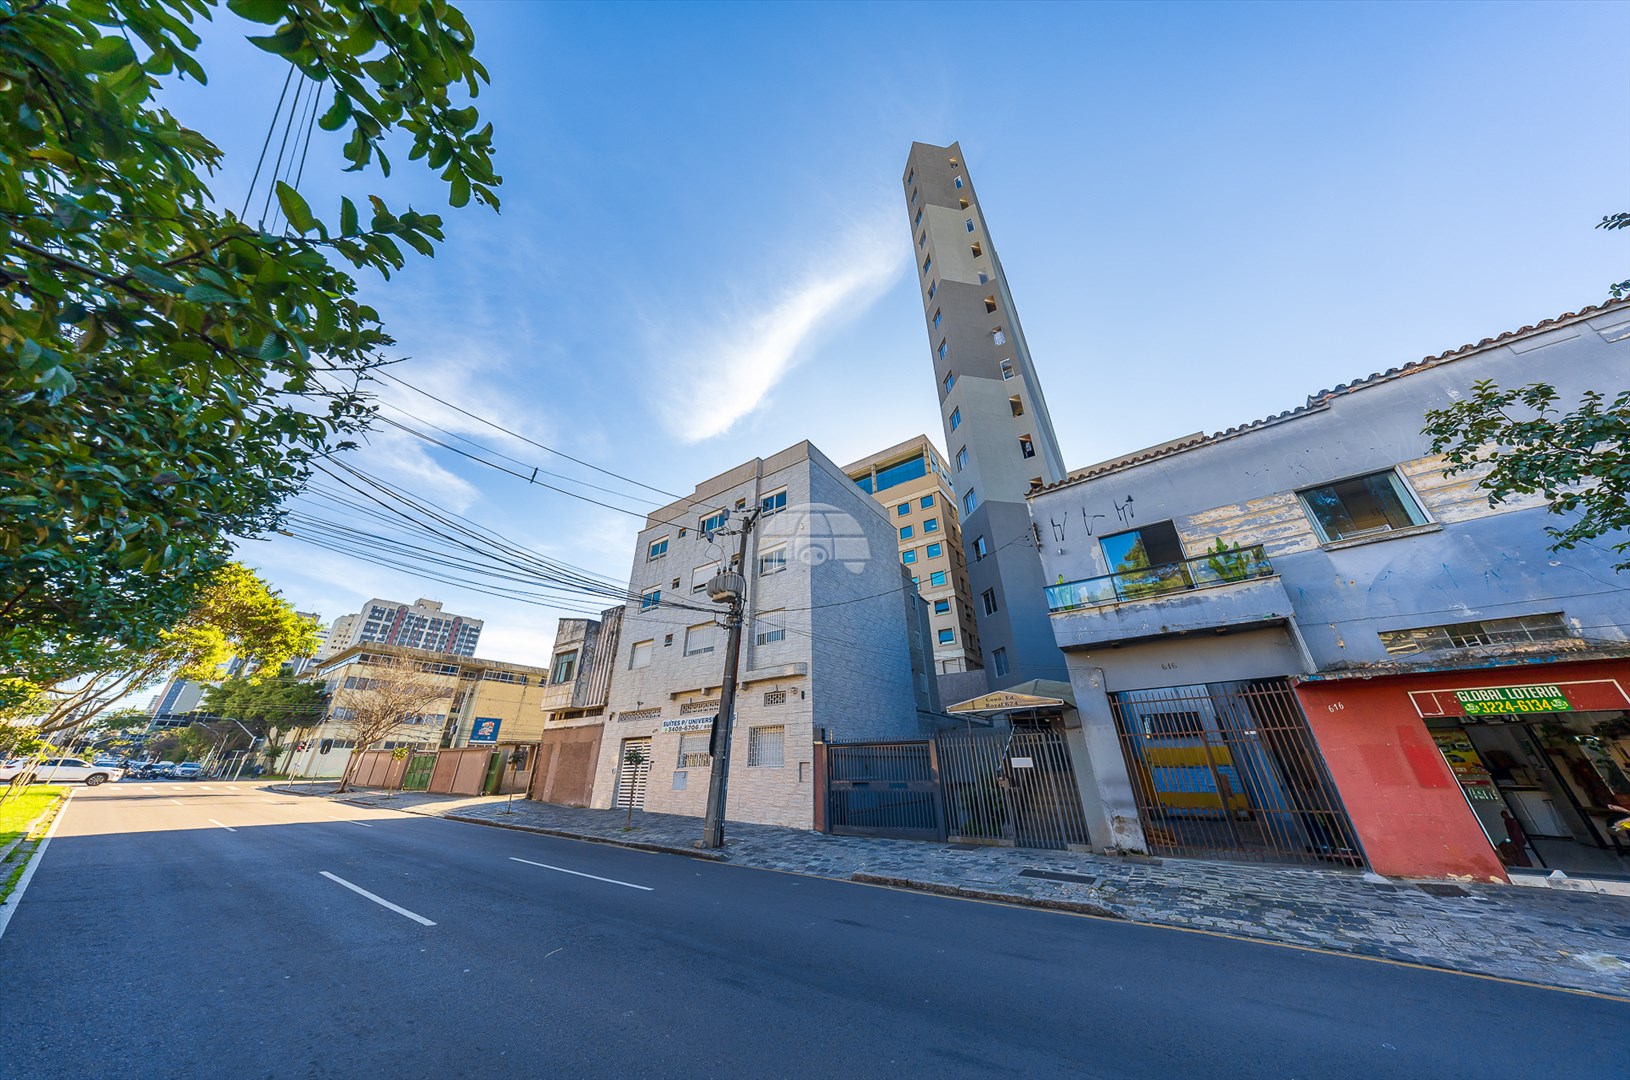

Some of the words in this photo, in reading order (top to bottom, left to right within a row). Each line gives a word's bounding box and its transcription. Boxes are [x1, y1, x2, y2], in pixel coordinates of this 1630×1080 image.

[1161, 662, 1178, 670] 616
[1456, 689, 1506, 702] GLOBAL
[1505, 686, 1562, 699] LOTERIA
[1328, 701, 1345, 713] 616
[1479, 699, 1552, 713] 3224-6134
